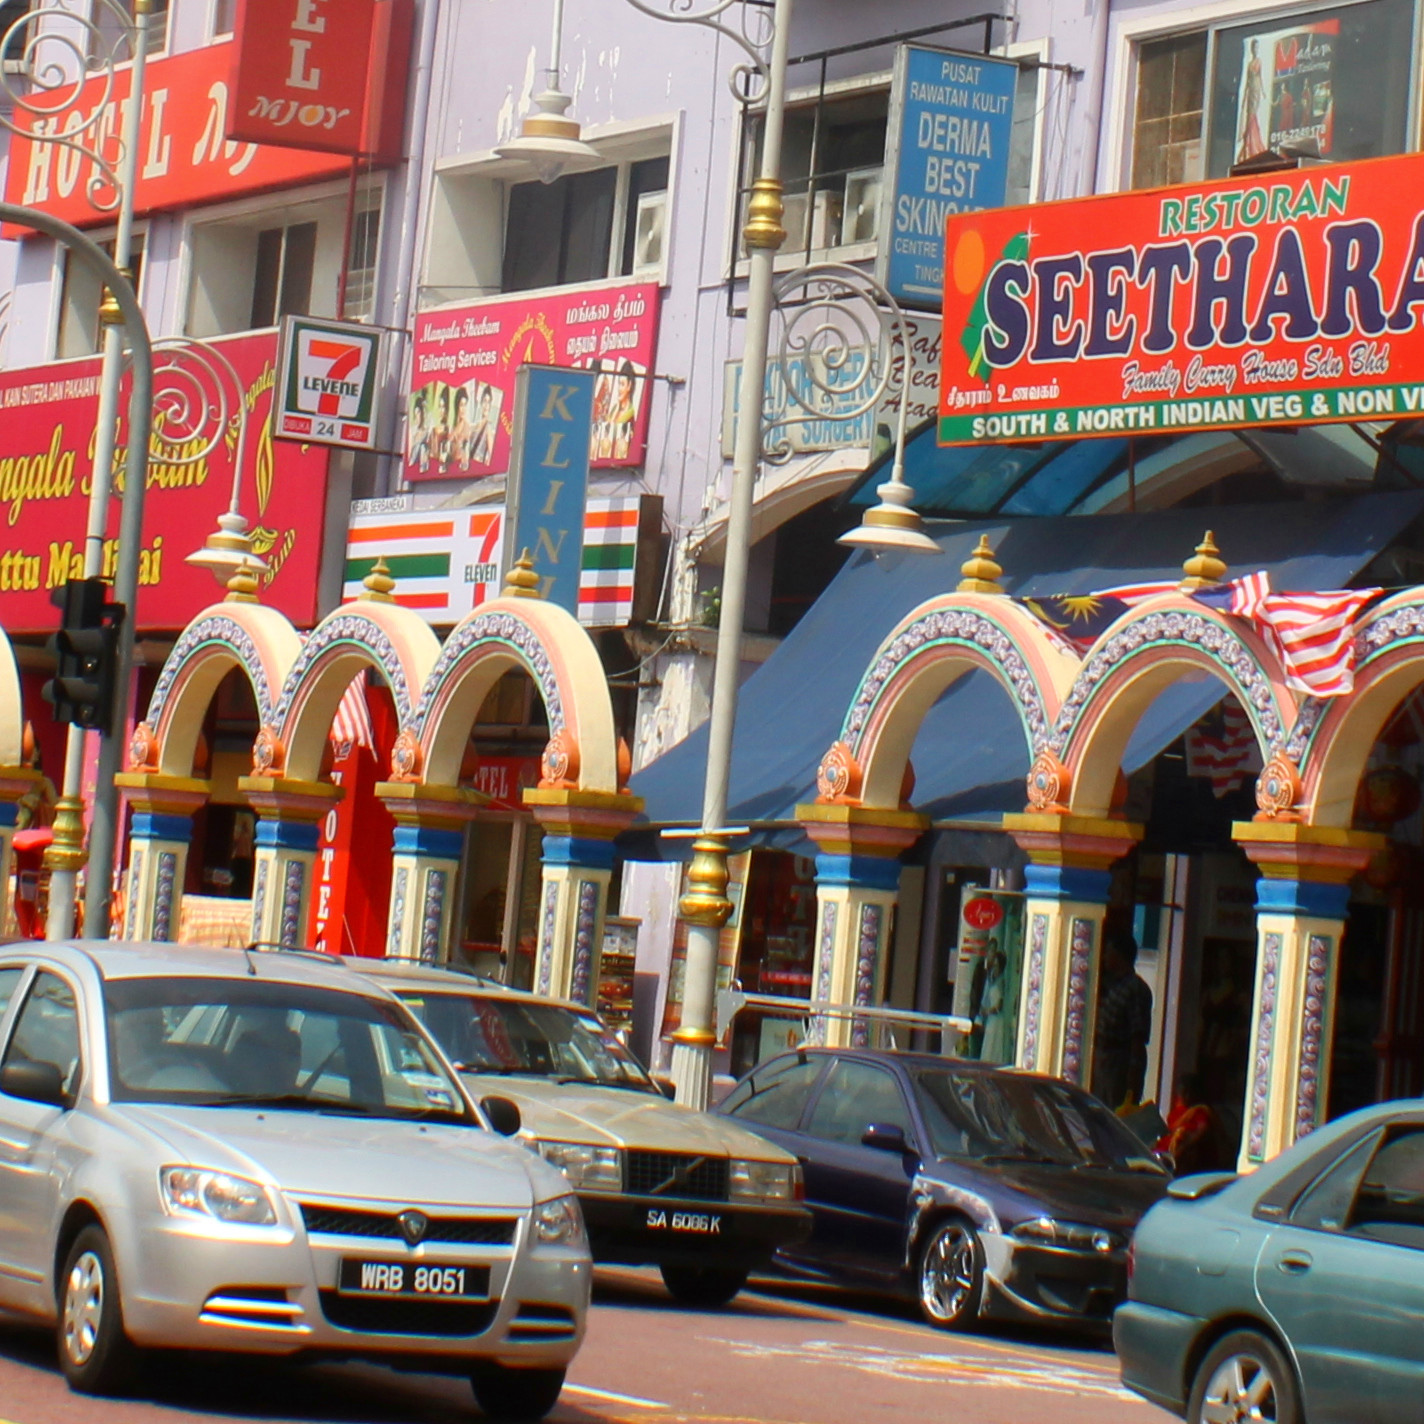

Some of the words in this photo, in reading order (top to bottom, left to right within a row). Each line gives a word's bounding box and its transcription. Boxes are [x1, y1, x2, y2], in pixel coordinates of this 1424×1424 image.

[942, 60, 982, 86] PUSAT
[910, 81, 968, 108] RAWATAN
[972, 88, 1009, 115] KULIT
[917, 111, 992, 160] DERMA
[924, 156, 981, 200] BEST
[1159, 175, 1351, 238] RESTORAN
[894, 238, 938, 258] CENTRE
[418, 352, 457, 374] Tailoring
[457, 349, 497, 368] Services
[1123, 359, 1181, 400] Family
[1183, 354, 1237, 394] Curry
[1240, 347, 1298, 384] House
[1303, 344, 1342, 379] Sdn
[1345, 339, 1390, 376] Bhd
[4, 386, 22, 408] KAIN
[49, 380, 64, 402] DAN
[317, 421, 335, 437] 24
[971, 413, 1047, 438] SOUTH
[1053, 411, 1070, 434] &
[1076, 405, 1155, 432] NORTH
[1162, 400, 1246, 428] INDIAN
[1251, 393, 1305, 421] VEG
[1310, 390, 1332, 417] &
[1339, 387, 1394, 416] NON
[646, 1209, 668, 1229] SA
[710, 1215, 722, 1233] K
[361, 1262, 404, 1293] WRB
[413, 1266, 466, 1295] 8051
